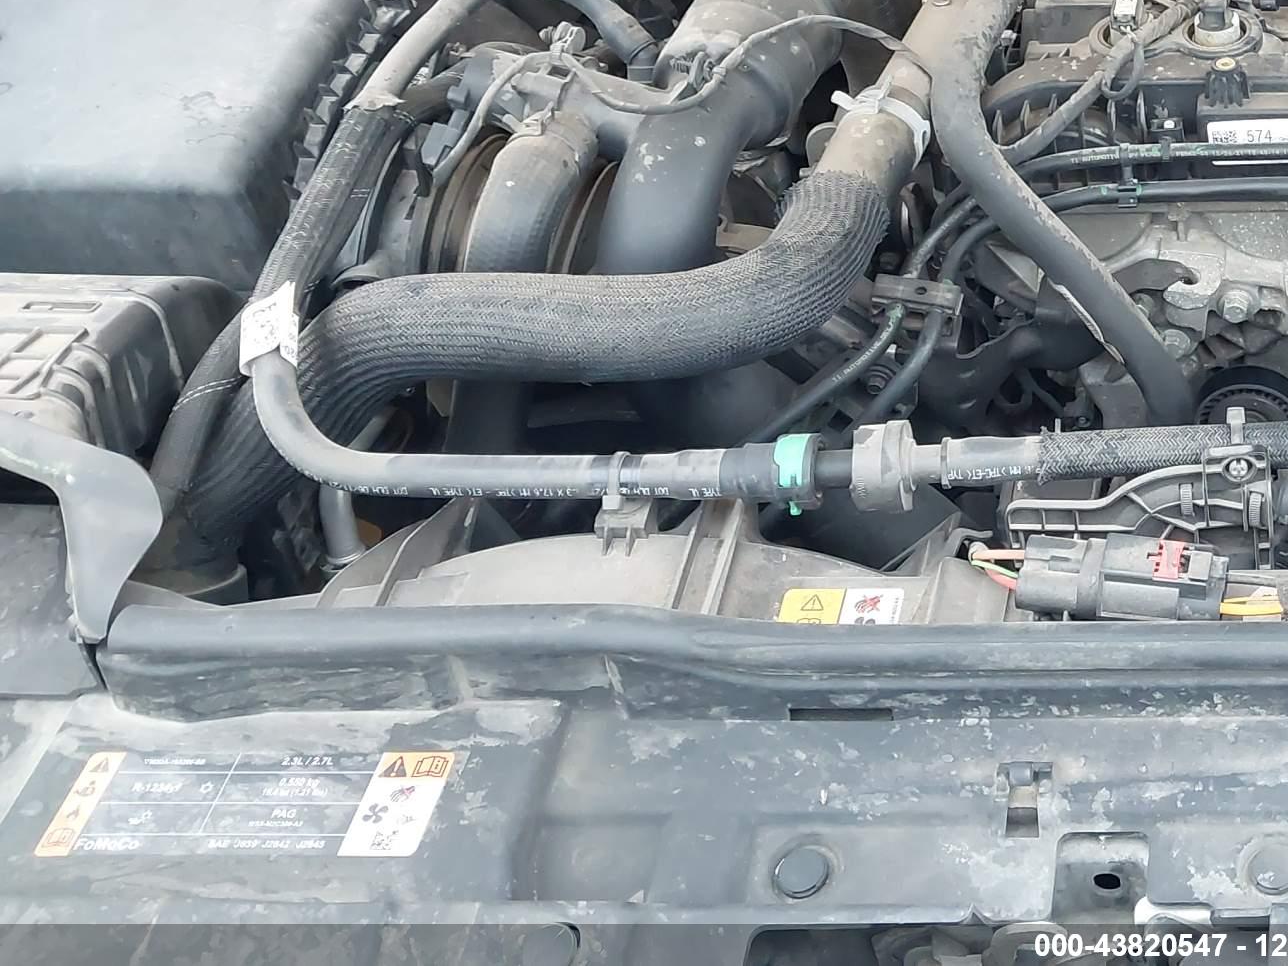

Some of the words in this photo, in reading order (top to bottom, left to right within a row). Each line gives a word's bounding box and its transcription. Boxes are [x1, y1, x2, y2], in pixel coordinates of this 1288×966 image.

[1246, 129, 1273, 143] 574
[947, 470, 964, 480] TYP
[271, 808, 297, 819] PAG
[73, 837, 140, 850] FoMoCo
